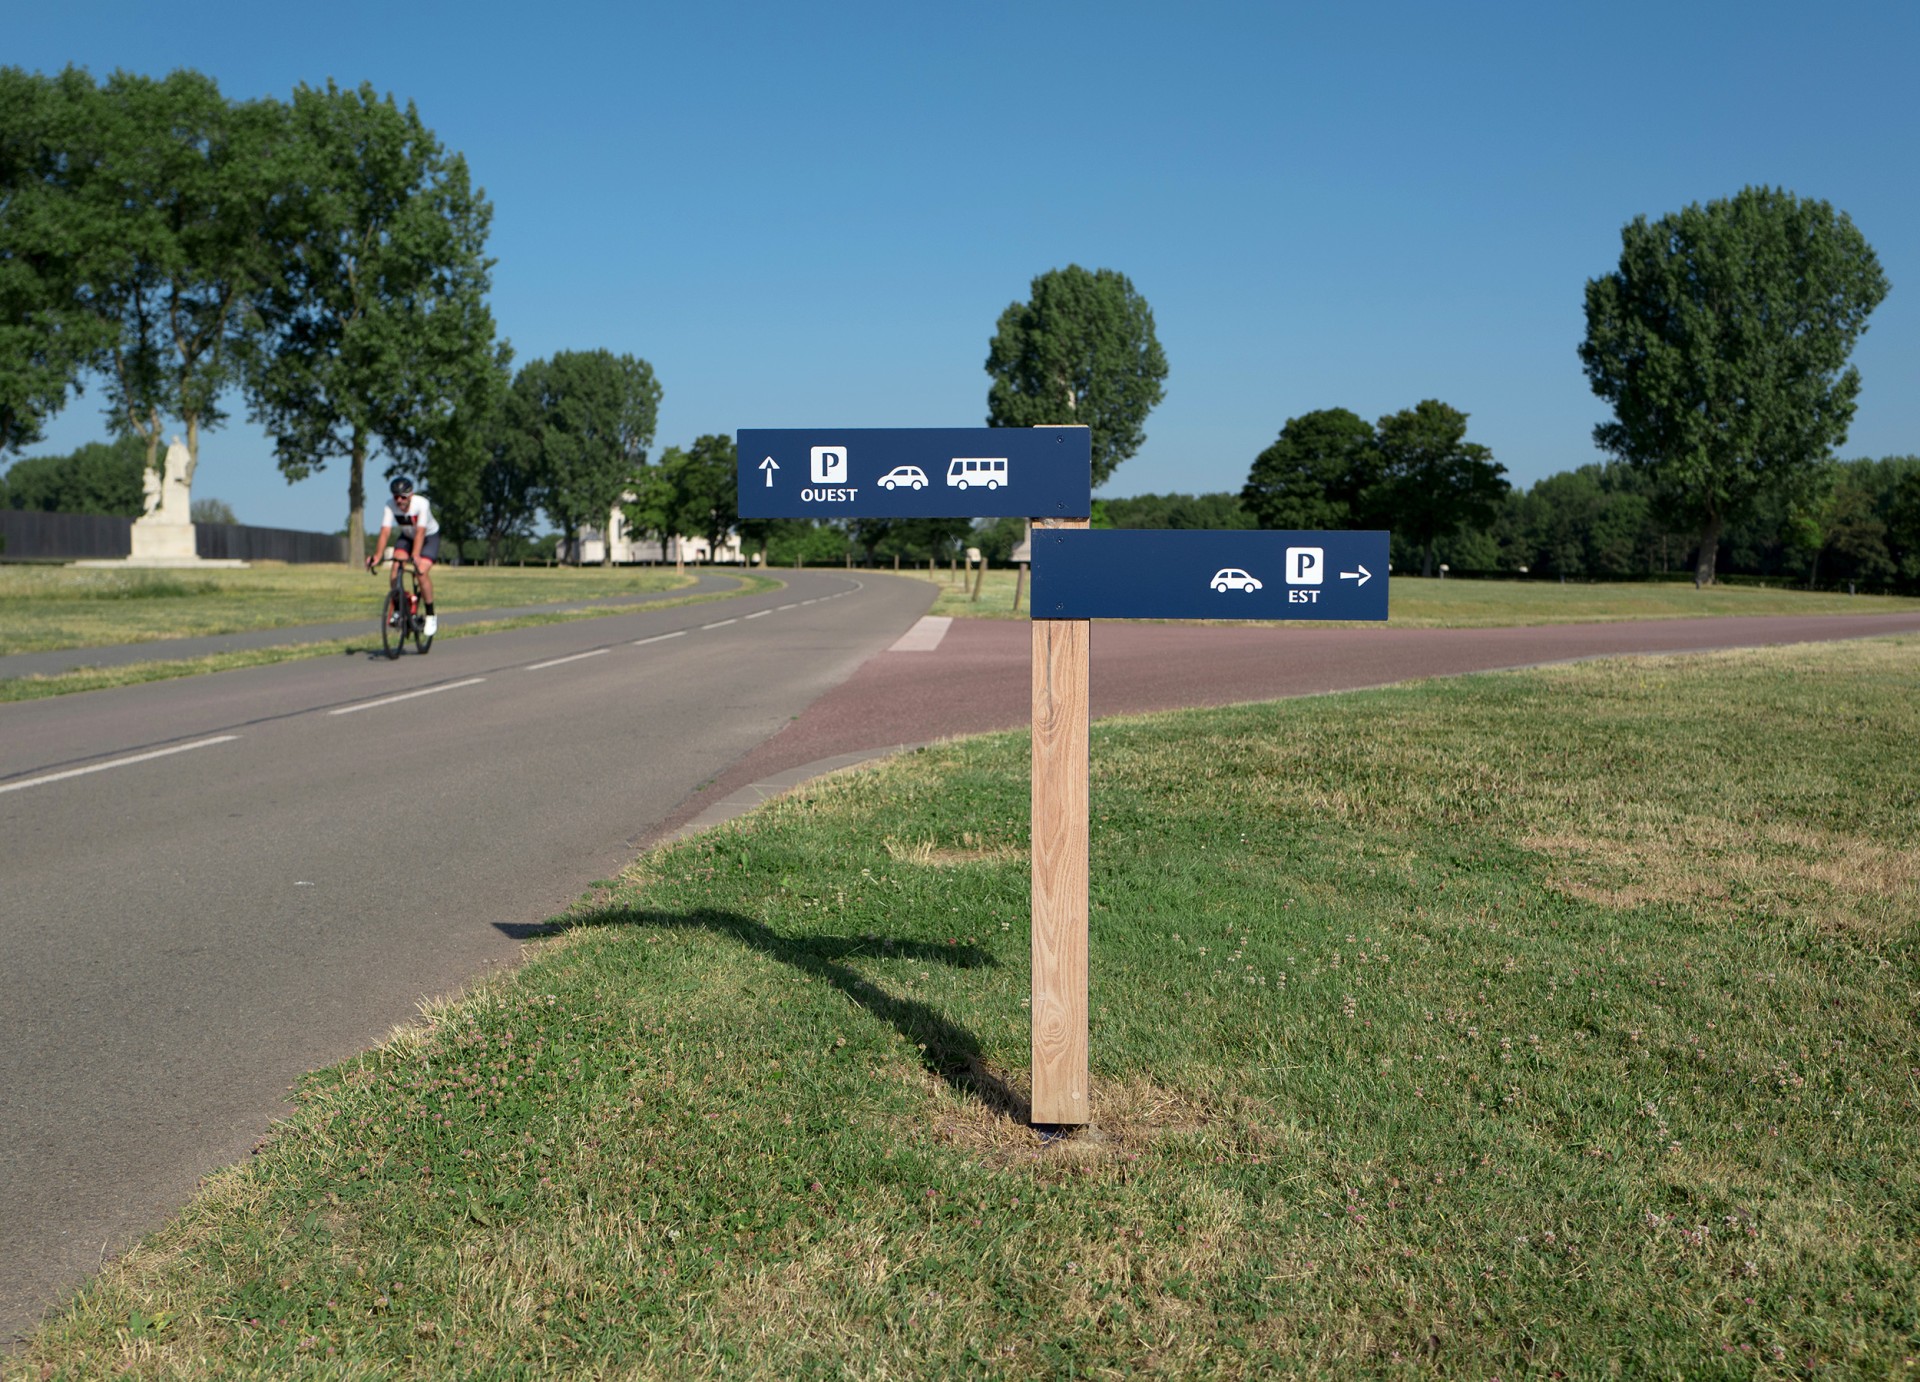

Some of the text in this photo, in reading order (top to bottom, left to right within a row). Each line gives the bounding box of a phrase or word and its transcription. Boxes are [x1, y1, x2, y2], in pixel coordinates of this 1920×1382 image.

[821, 452, 840, 477] P
[800, 488, 858, 502] OUEST
[1297, 553, 1316, 578] P
[1288, 589, 1321, 603] EST
